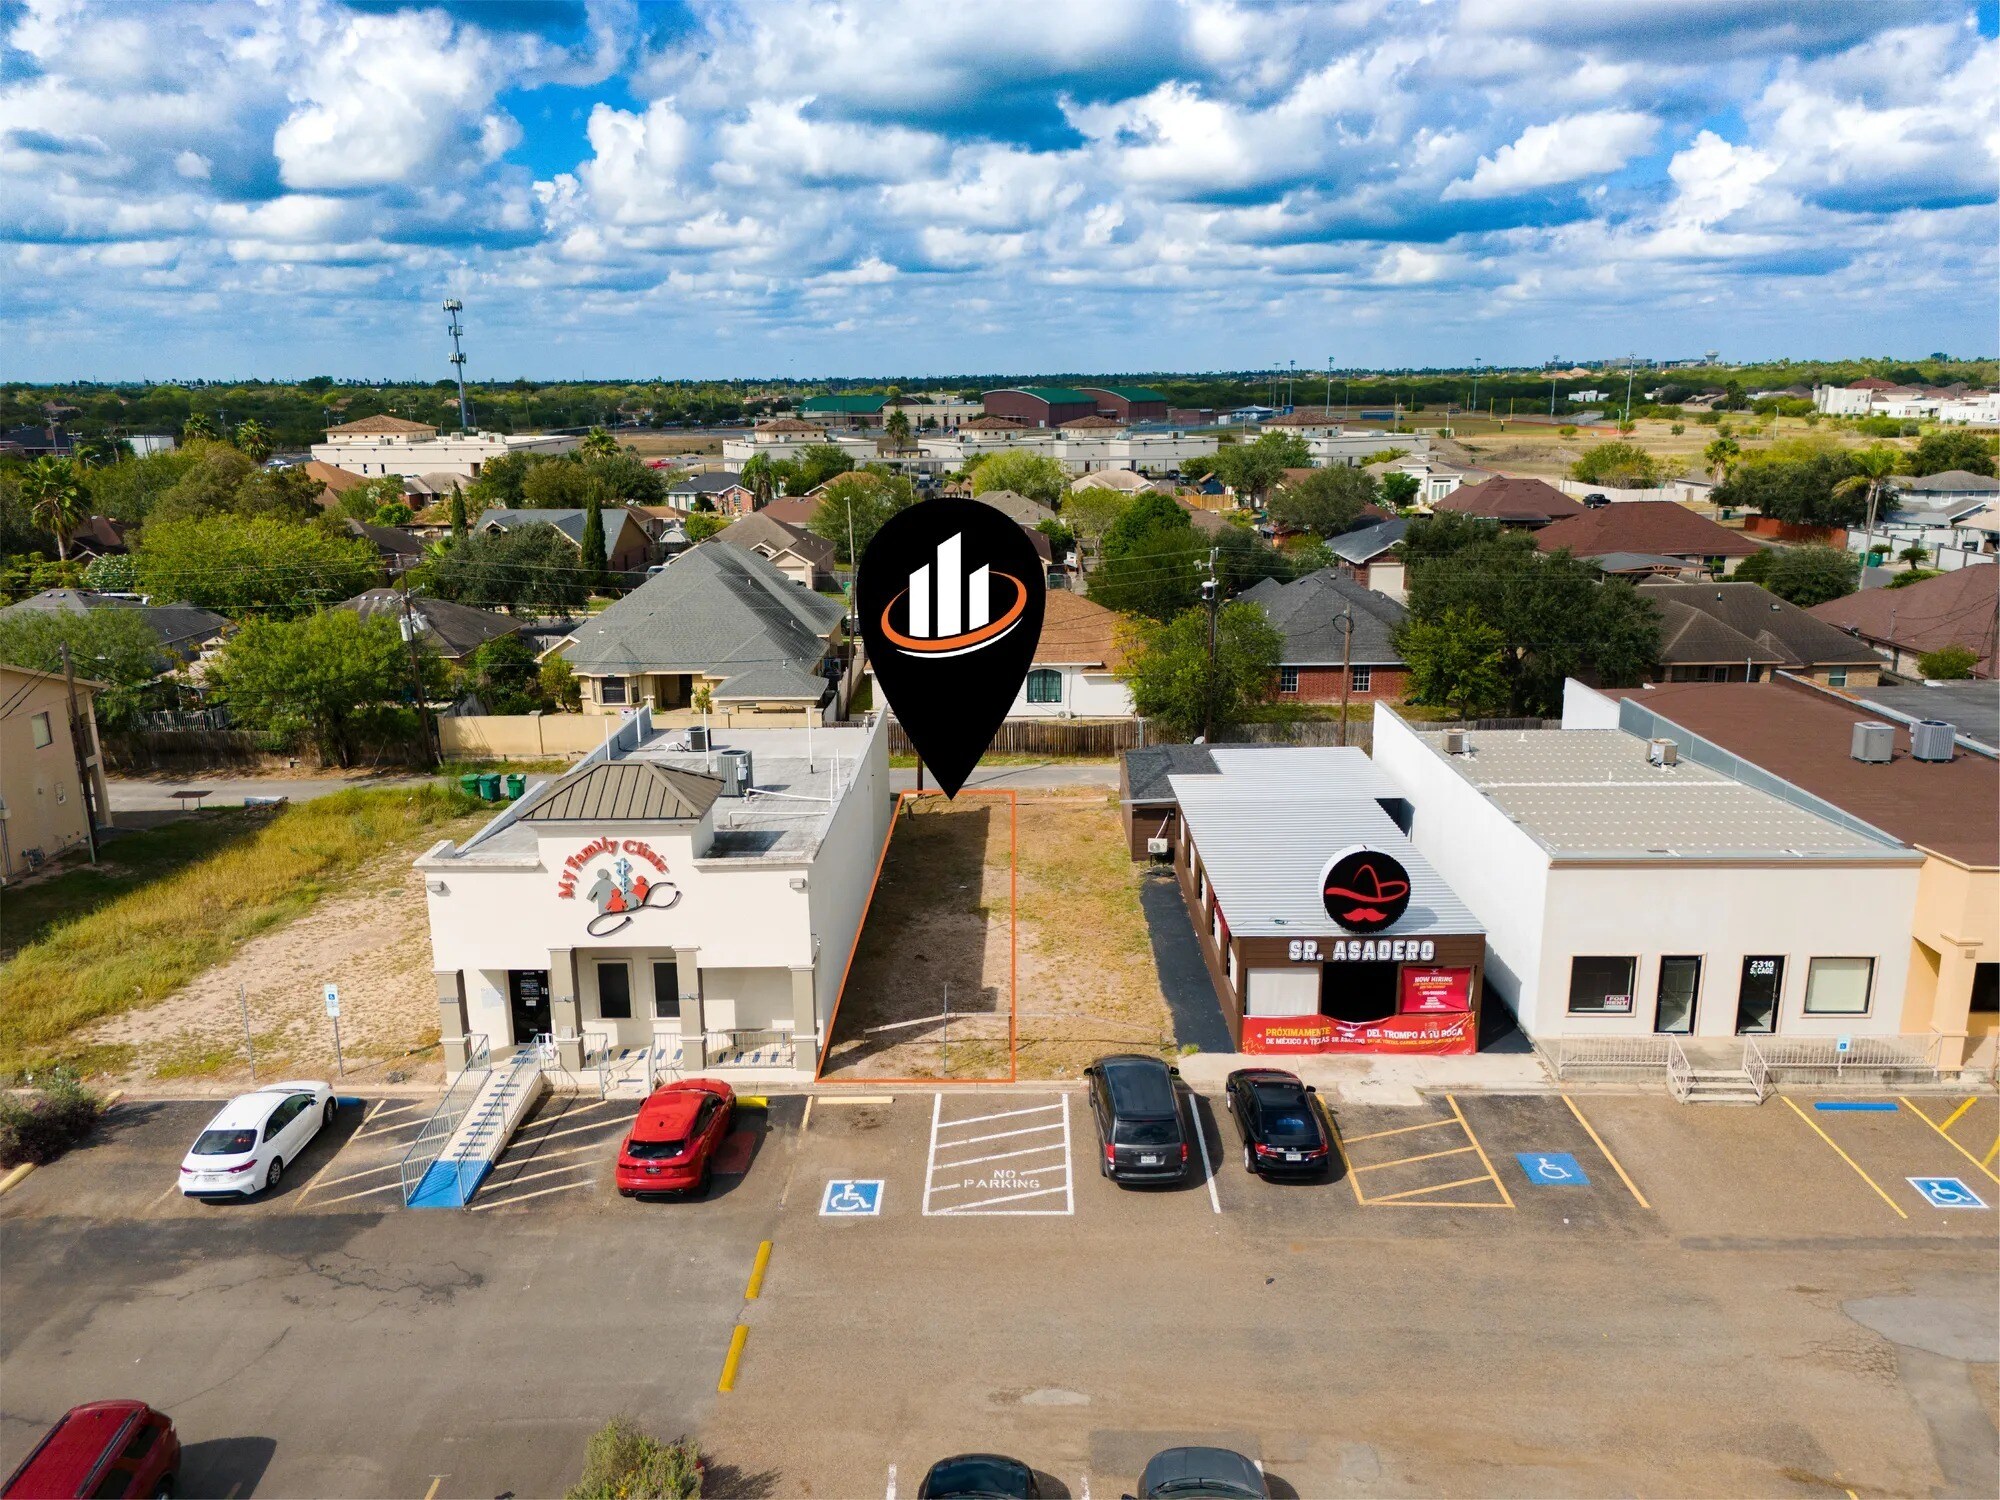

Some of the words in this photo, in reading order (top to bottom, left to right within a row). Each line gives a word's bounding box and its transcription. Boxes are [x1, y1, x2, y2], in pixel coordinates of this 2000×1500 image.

[565, 836, 618, 871] Family
[622, 839, 669, 874] Clinic
[558, 869, 578, 899] My
[1288, 940, 1324, 961] SR.
[1332, 940, 1435, 961] ASADERO
[1751, 960, 1775, 968] 2310
[1366, 1029, 1381, 1038] DEL
[1383, 1030, 1418, 1039] TROMPO
[1420, 1031, 1427, 1039] A
[1428, 1030, 1439, 1039] TU
[993, 1169, 1016, 1179] NO
[963, 1179, 1040, 1189] PARKING
